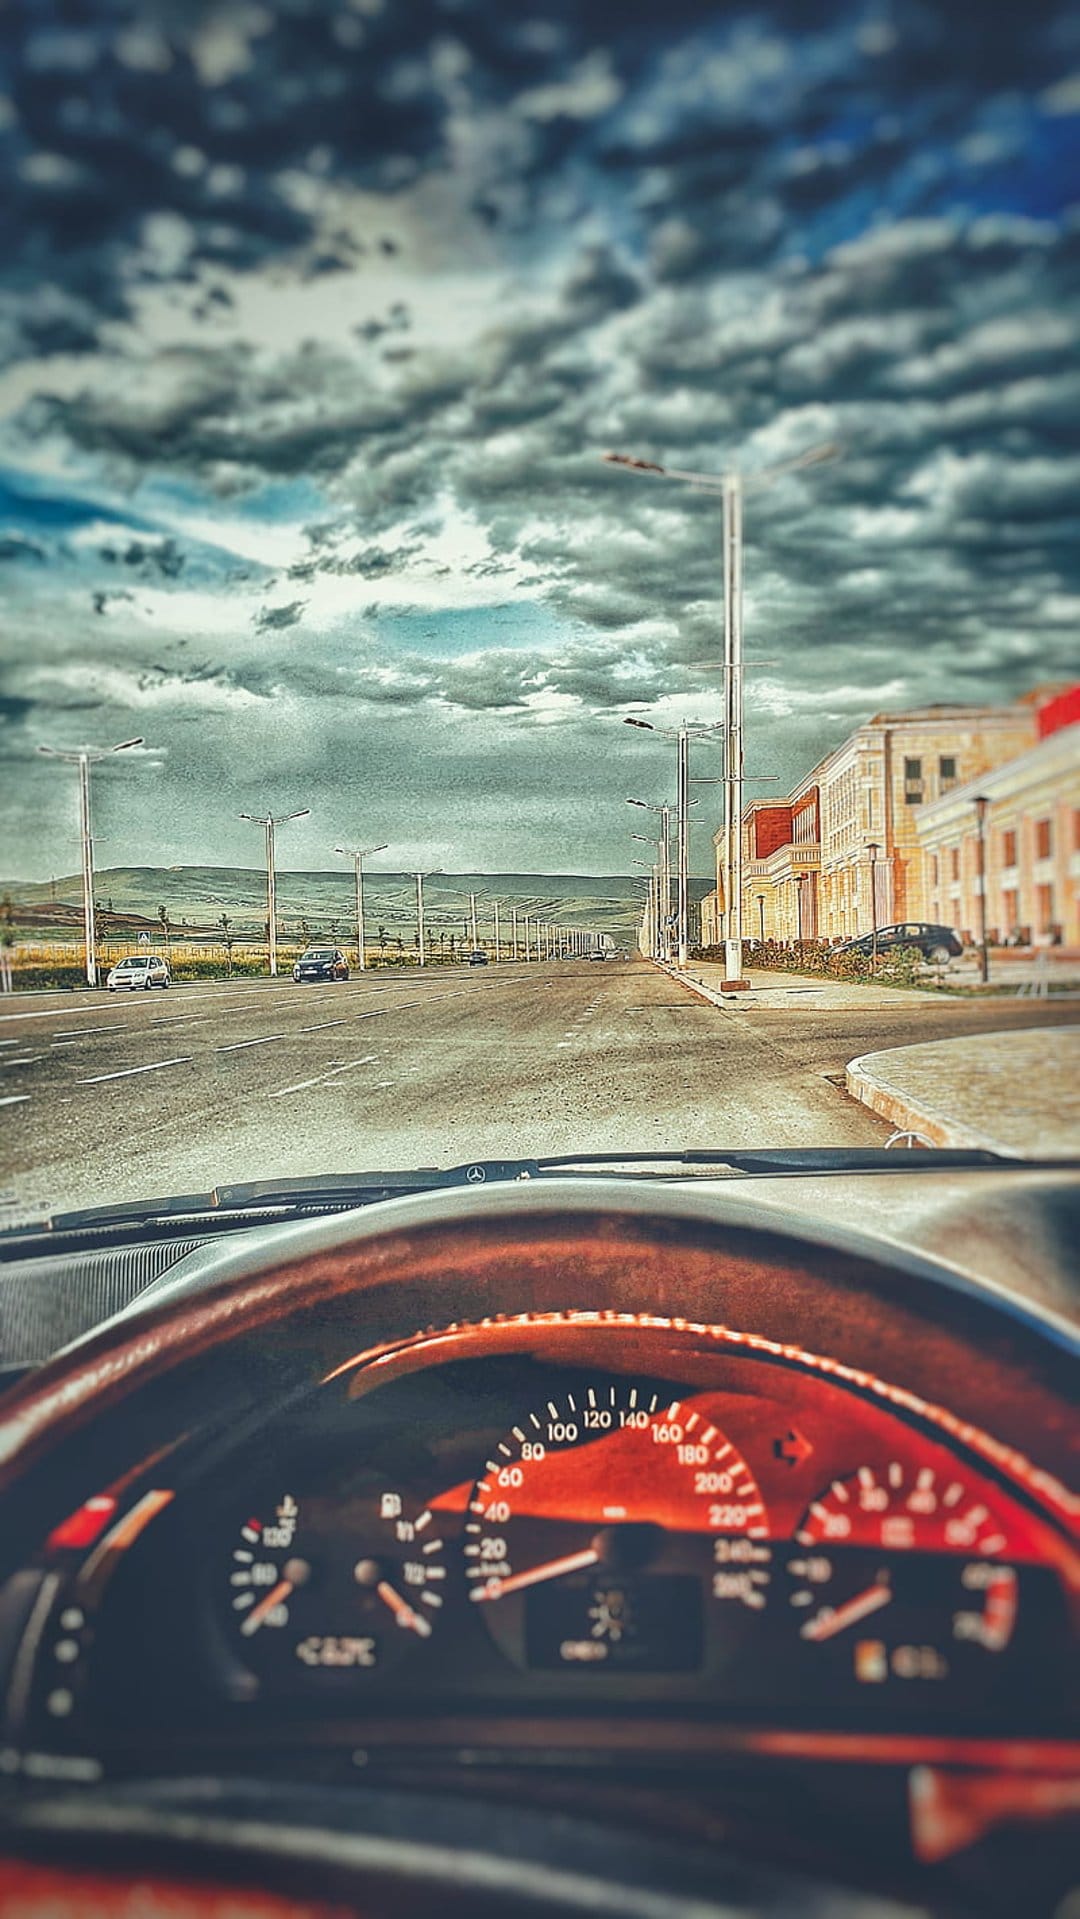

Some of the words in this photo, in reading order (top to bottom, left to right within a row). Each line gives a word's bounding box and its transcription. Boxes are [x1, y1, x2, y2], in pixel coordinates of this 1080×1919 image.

[584, 1411, 612, 1428] 120
[619, 1410, 649, 1429] 140
[548, 1423, 578, 1441] 100
[651, 1423, 683, 1443] 160
[521, 1443, 545, 1461] 80
[677, 1445, 708, 1464] 180
[498, 1468, 523, 1487] 60
[695, 1473, 732, 1493] 200
[484, 1501, 510, 1522] 40
[709, 1504, 747, 1527] 220
[480, 1537, 507, 1559] 20
